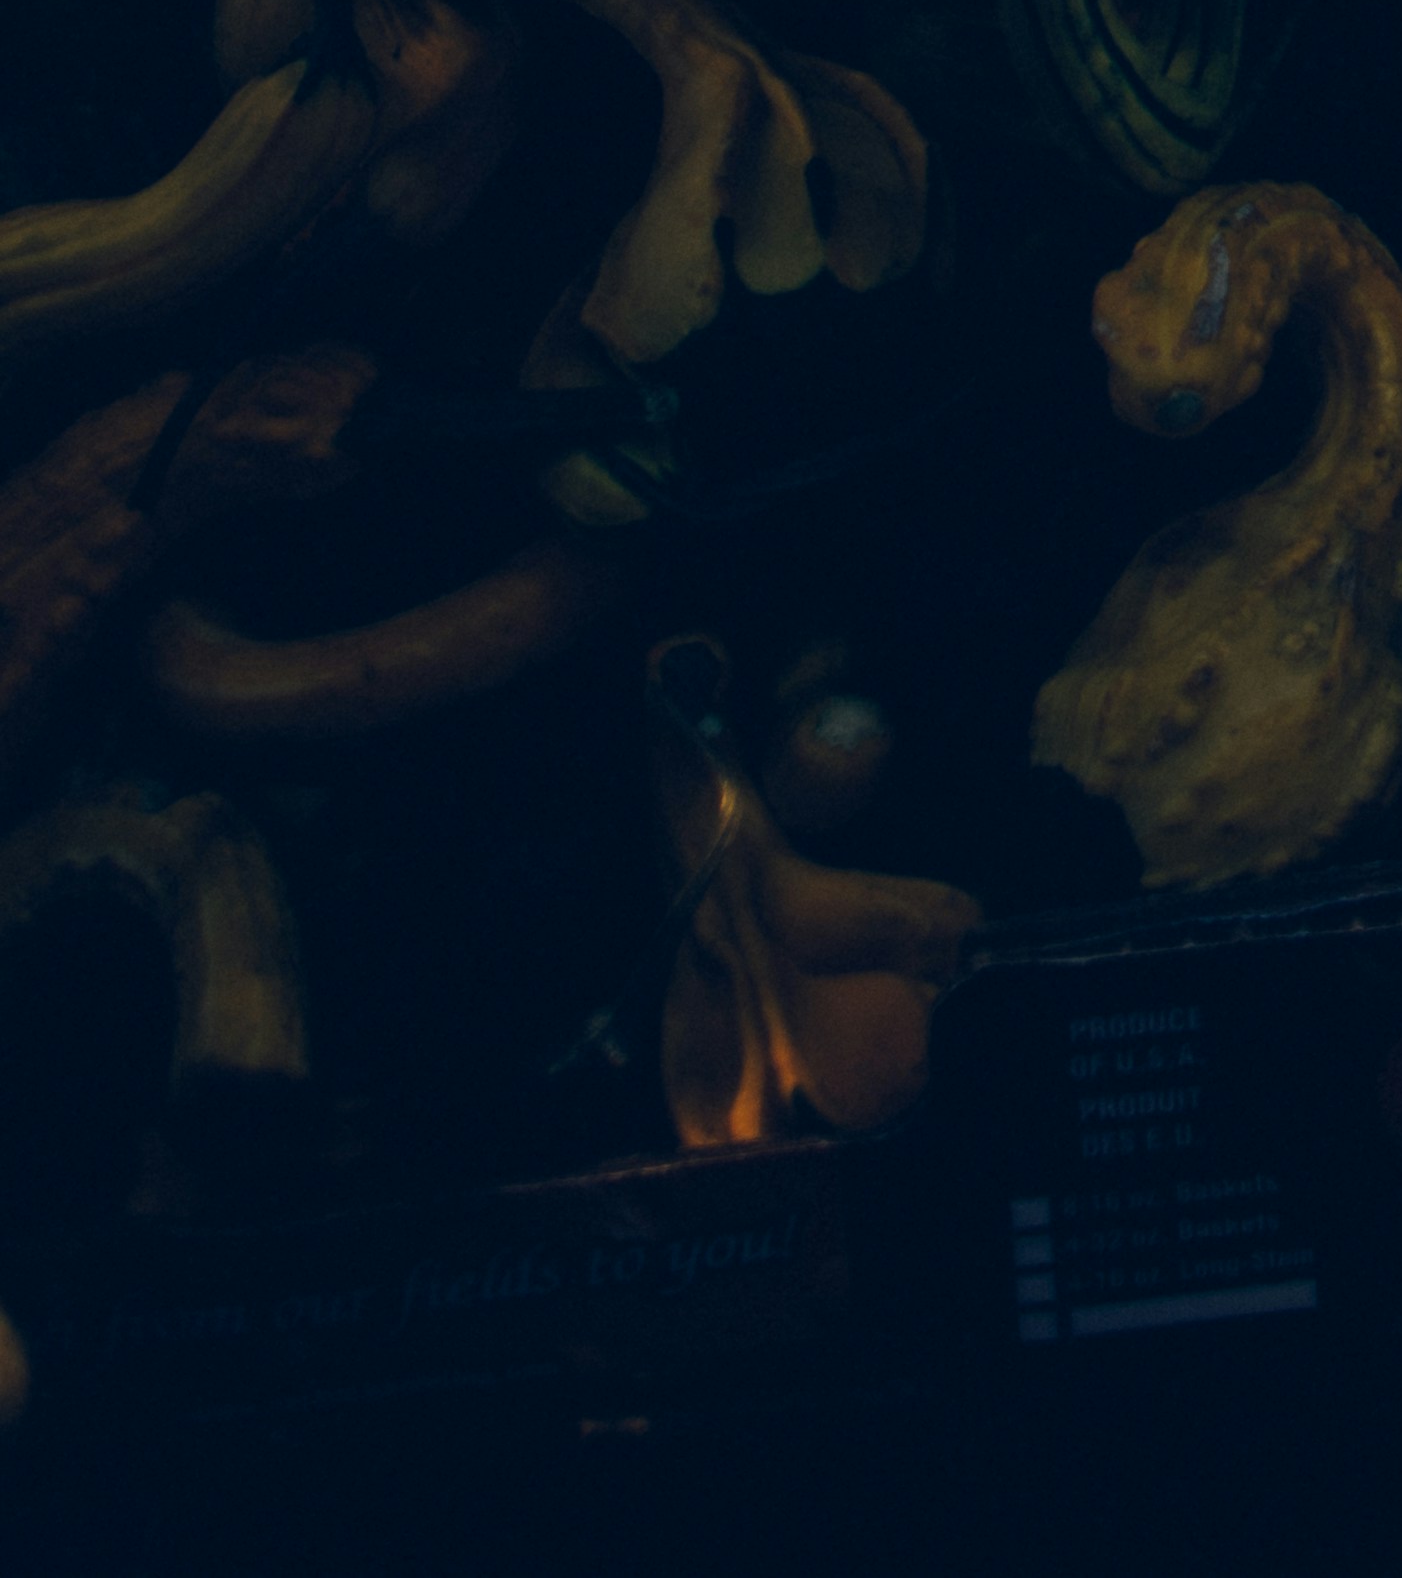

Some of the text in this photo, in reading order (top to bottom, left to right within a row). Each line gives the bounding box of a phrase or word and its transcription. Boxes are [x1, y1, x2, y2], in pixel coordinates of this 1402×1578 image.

[1069, 1005, 1203, 1043] PRODUCE
[1068, 1053, 1105, 1081] OF
[1078, 1085, 1202, 1122] PRODUIT
